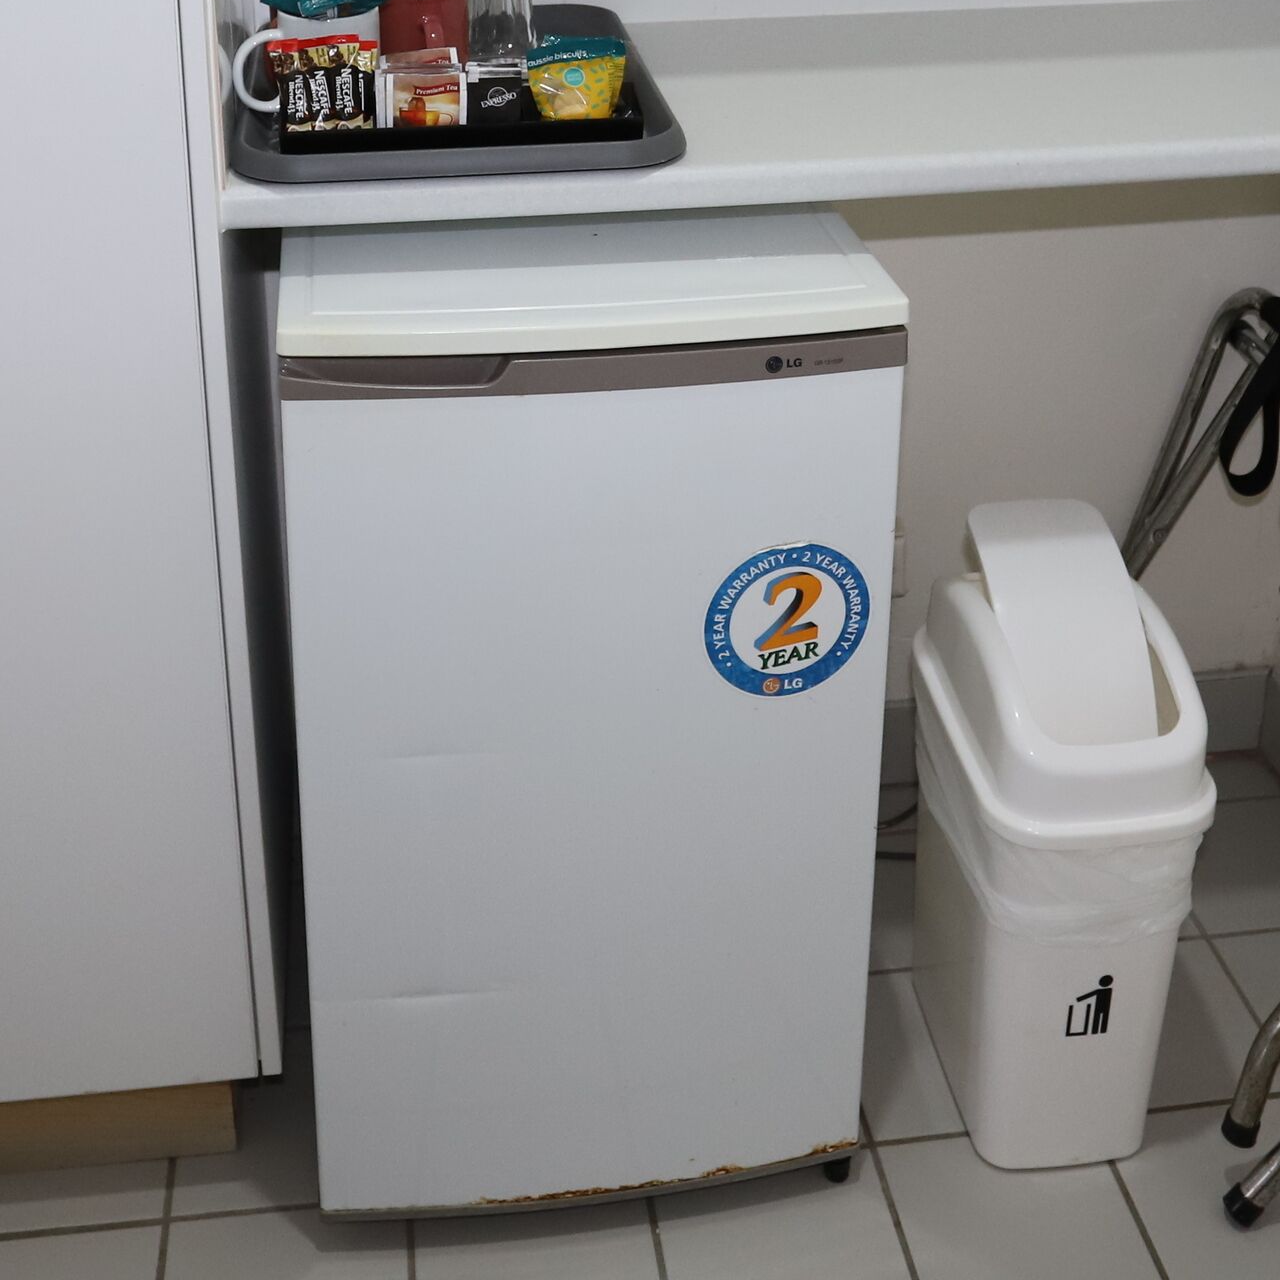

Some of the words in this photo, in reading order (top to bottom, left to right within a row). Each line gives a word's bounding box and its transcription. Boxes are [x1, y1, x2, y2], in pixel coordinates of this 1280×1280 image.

[528, 55, 554, 67] aussie
[554, 50, 587, 60] biscuits
[416, 86, 445, 95] Premium
[481, 92, 517, 108] EXPRESSO
[786, 358, 802, 368] LG
[718, 553, 786, 610] WARRANTY
[802, 552, 811, 562] 2
[815, 554, 846, 579] YEAR
[841, 575, 861, 650] WARRANTY
[754, 572, 822, 652] 2
[713, 614, 726, 649] YEAR
[718, 651, 730, 660] 2
[758, 642, 819, 670] YEAR
[784, 678, 803, 689] LG
